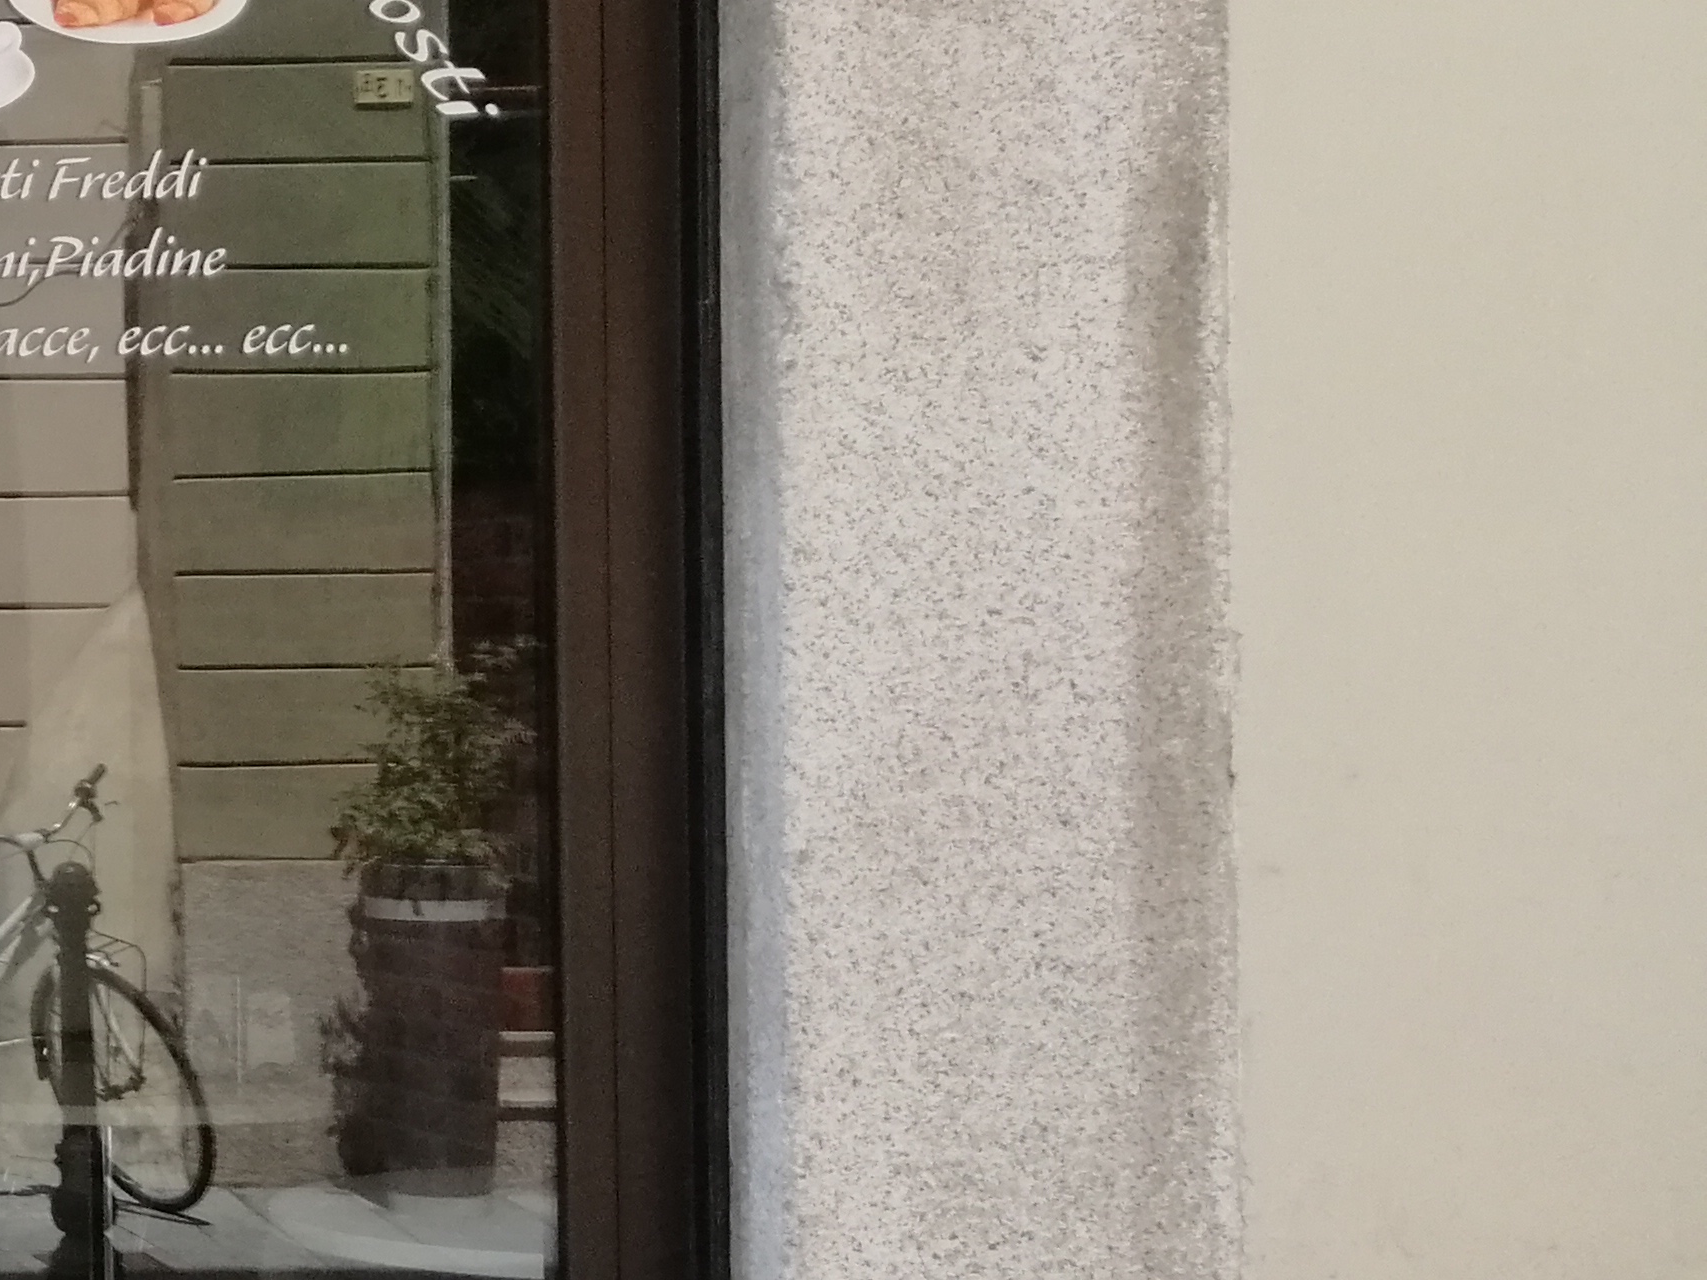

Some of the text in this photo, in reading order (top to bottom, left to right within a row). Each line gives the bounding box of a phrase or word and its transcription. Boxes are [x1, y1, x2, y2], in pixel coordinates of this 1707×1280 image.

[48, 147, 209, 201] Freddi
[118, 324, 225, 357] ecc...
[242, 322, 350, 356] ecc...
